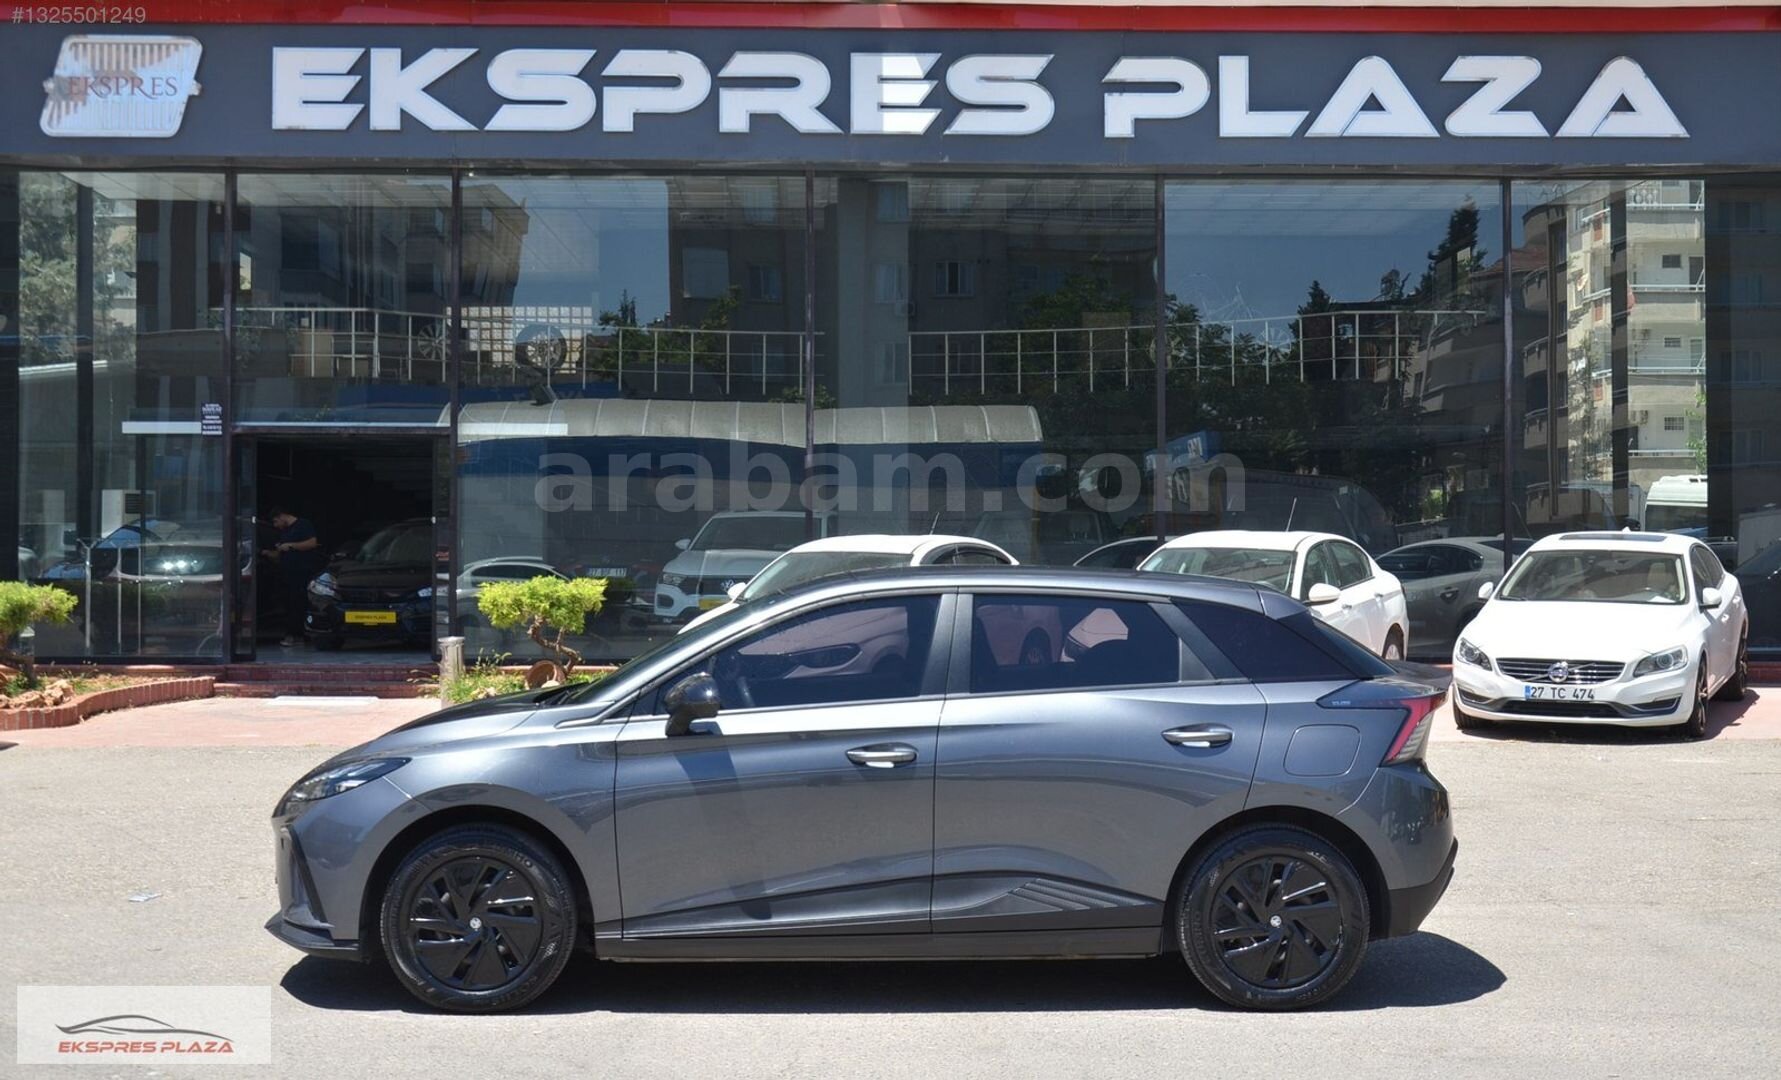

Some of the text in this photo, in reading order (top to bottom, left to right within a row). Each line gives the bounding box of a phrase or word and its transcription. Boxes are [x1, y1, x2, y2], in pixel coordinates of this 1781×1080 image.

[69, 76, 178, 99] EKSPRES
[272, 47, 1690, 138] EKSPRES PLAZA
[1531, 686, 1595, 699] 27 TC 474
